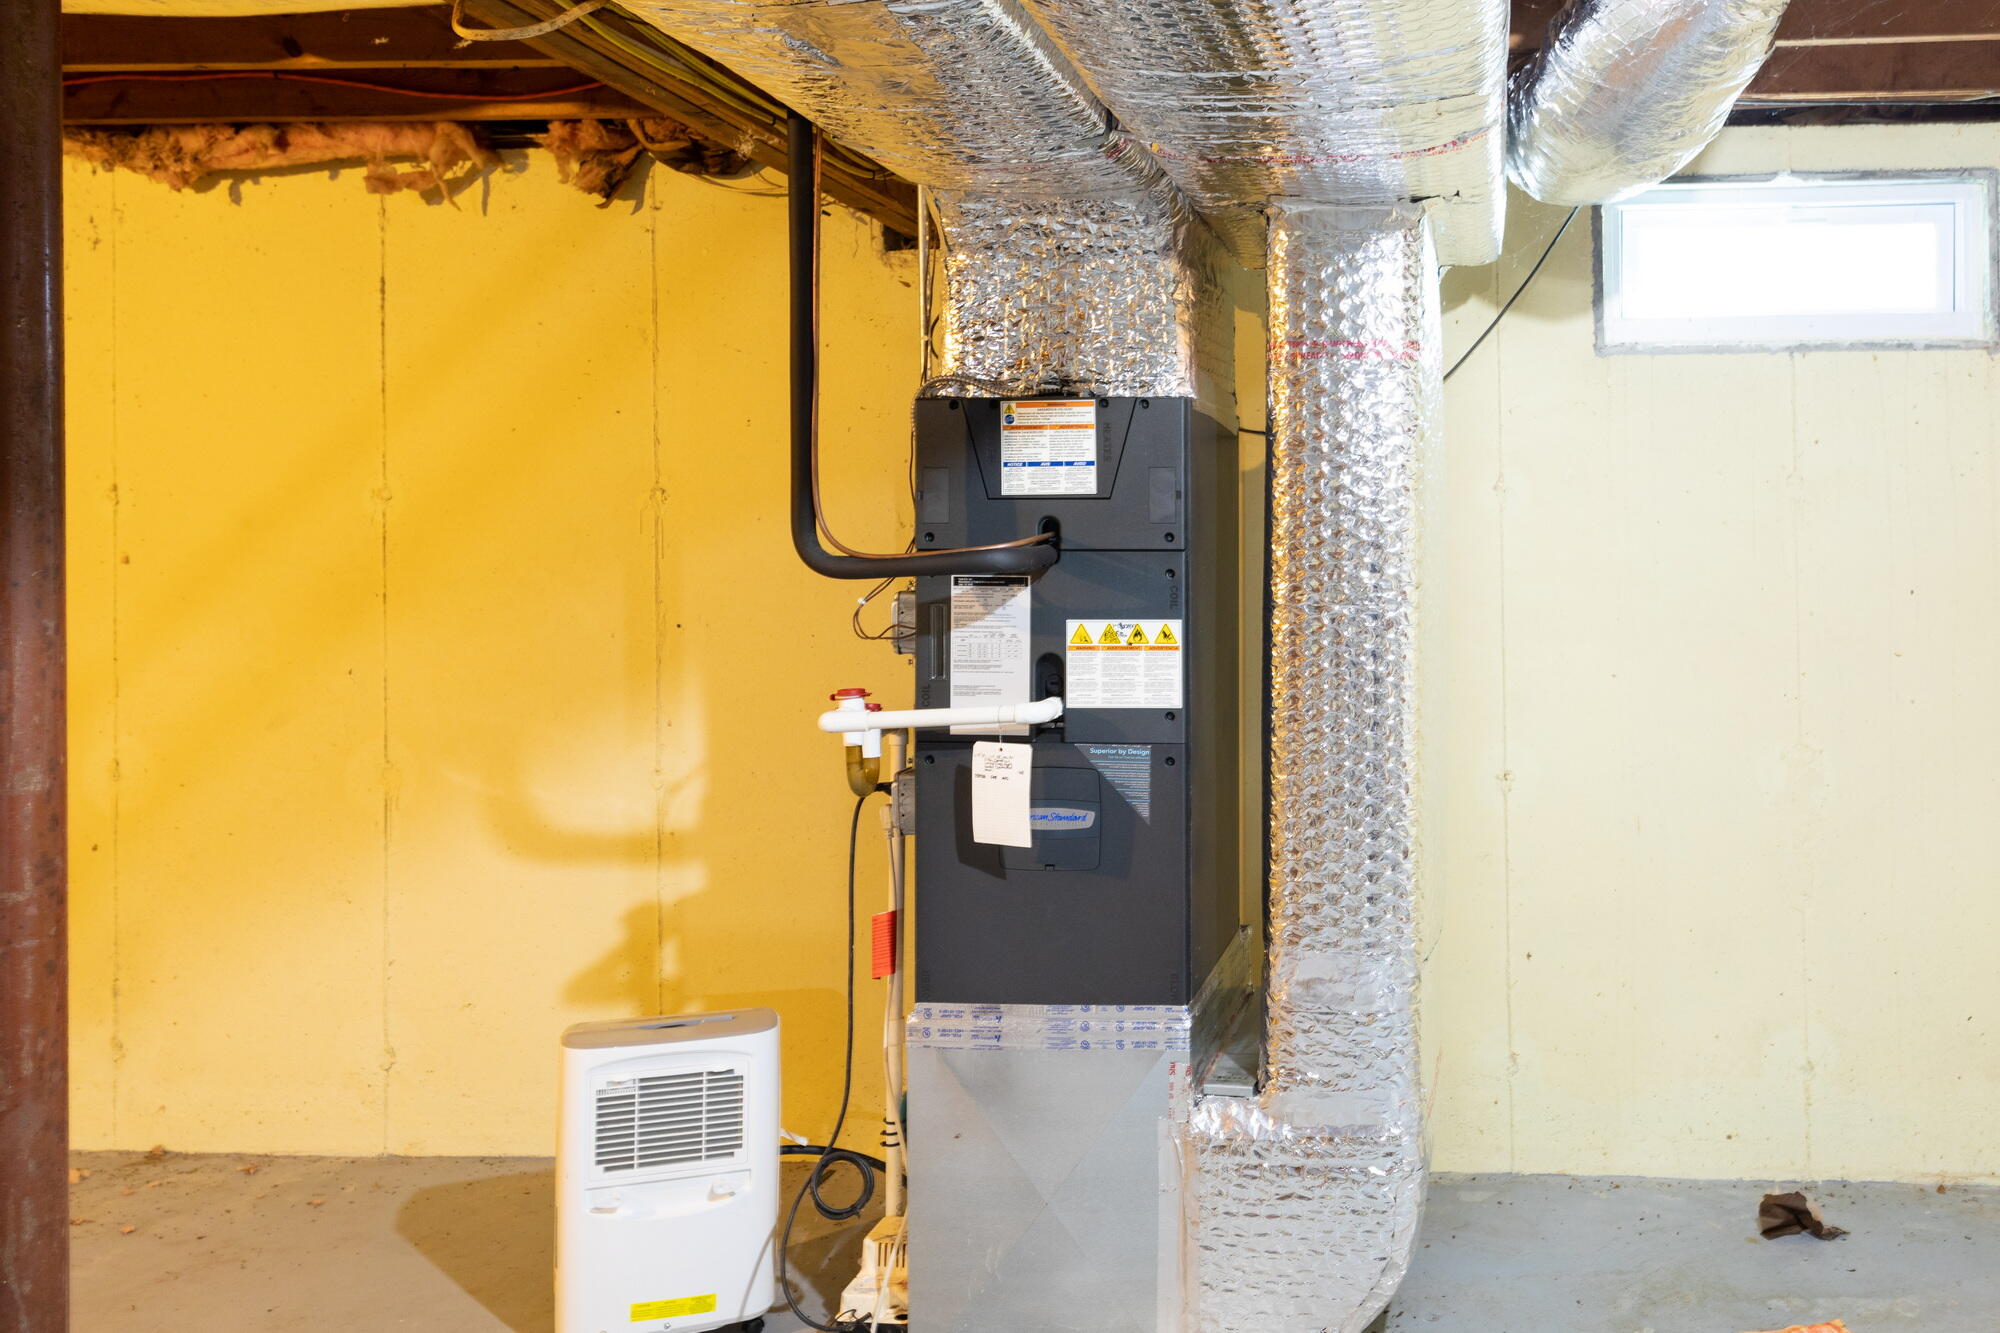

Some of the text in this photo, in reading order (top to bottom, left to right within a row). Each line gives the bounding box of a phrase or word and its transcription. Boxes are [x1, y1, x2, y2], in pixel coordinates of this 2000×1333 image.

[1103, 422, 1111, 464] HEATER
[1170, 586, 1178, 610] COIL
[920, 683, 930, 707] COIL
[1090, 747, 1117, 755] Superior
[1128, 748, 1150, 756] Design
[1048, 812, 1089, 822] Standard
